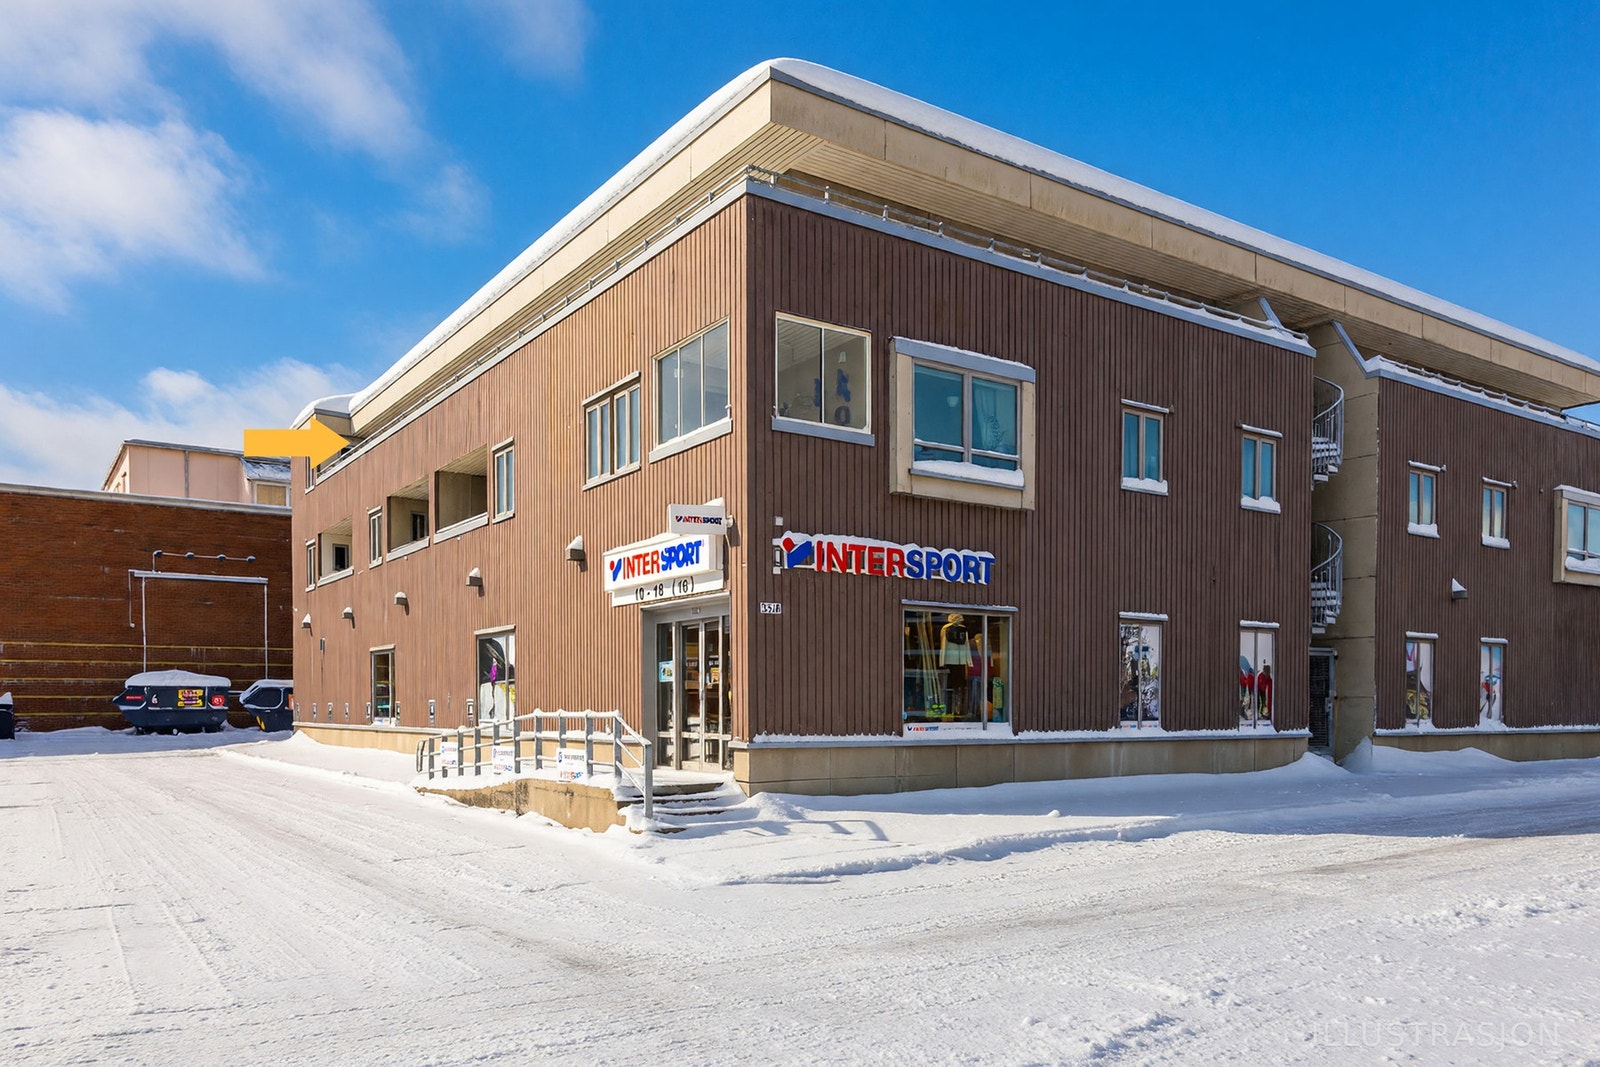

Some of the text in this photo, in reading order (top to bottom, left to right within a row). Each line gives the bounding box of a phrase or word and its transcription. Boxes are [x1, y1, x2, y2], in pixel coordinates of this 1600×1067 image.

[623, 540, 702, 580] INTERSPORT
[815, 540, 996, 585] INTERSPORT
[653, 583, 664, 598] 18
